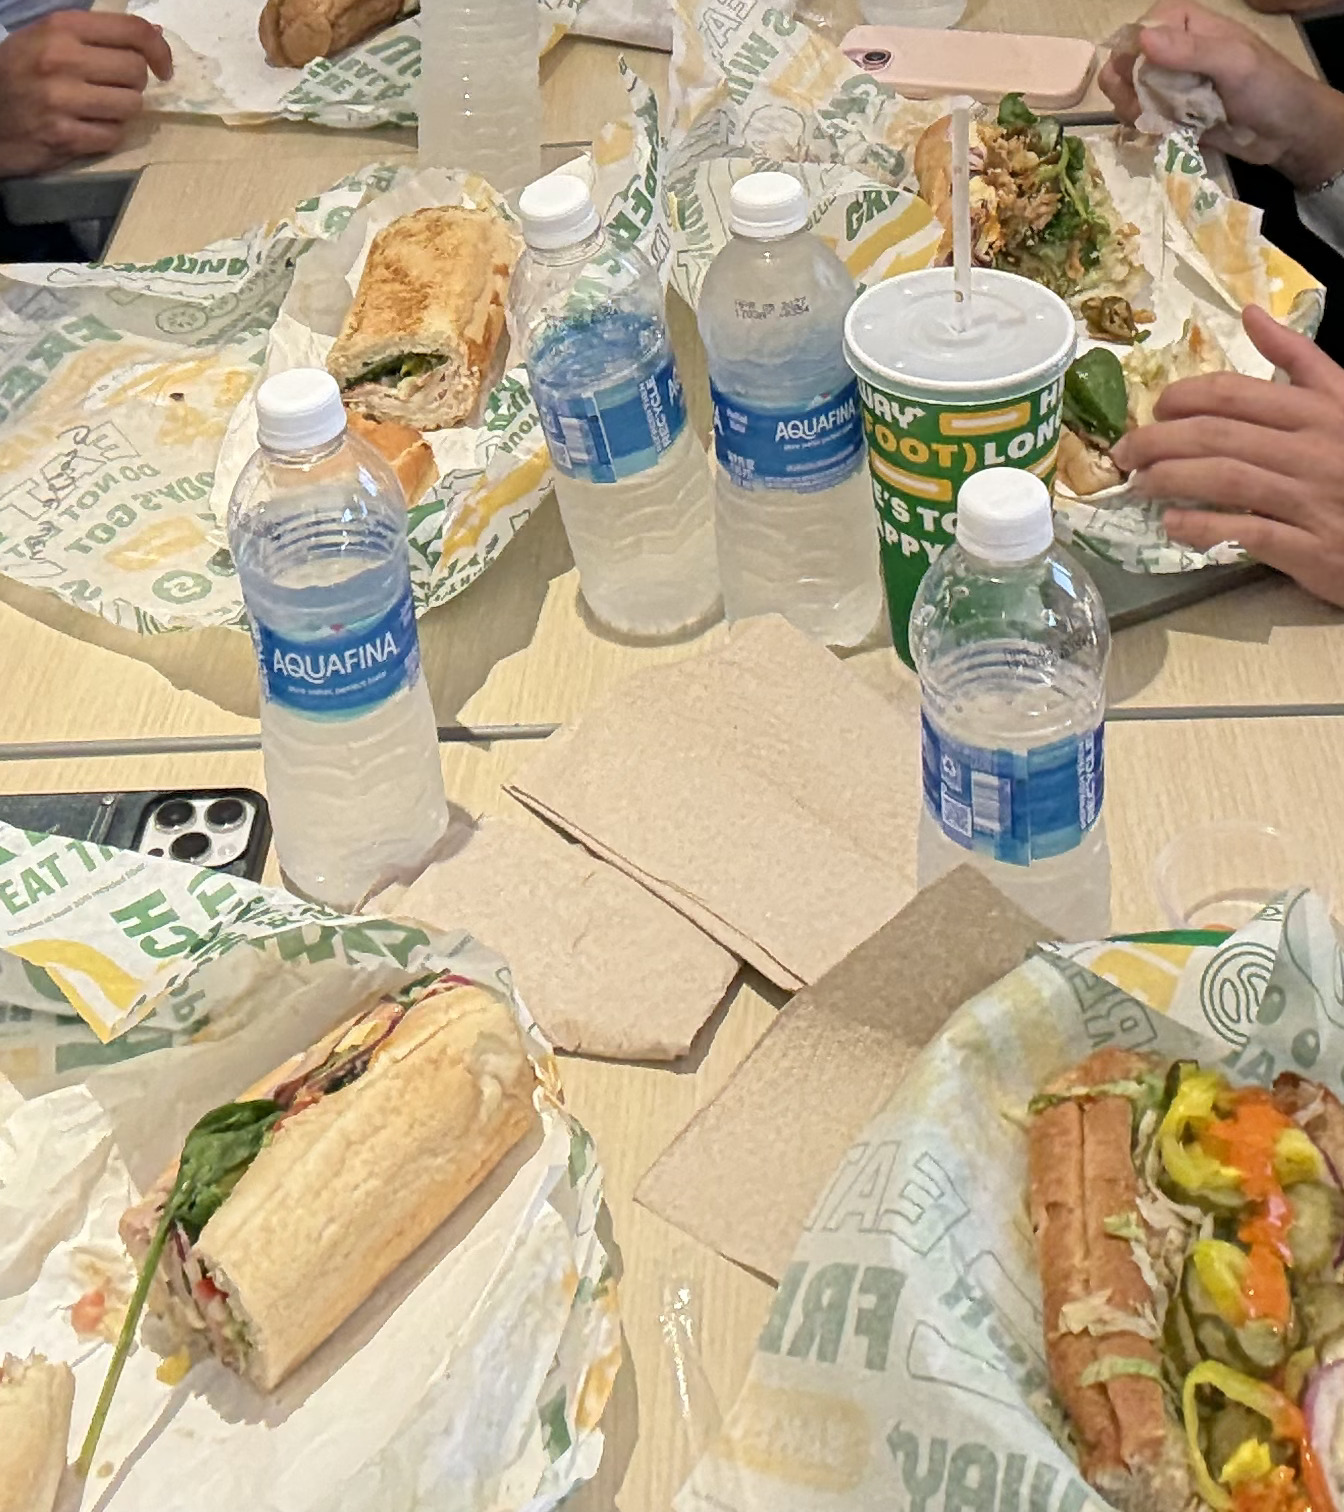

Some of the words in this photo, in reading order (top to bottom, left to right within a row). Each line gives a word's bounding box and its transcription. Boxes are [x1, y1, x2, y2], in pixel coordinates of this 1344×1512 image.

[774, 395, 857, 444] AQUAFINA
[877, 520, 944, 565] PPY
[273, 630, 400, 685] AQUAFINA
